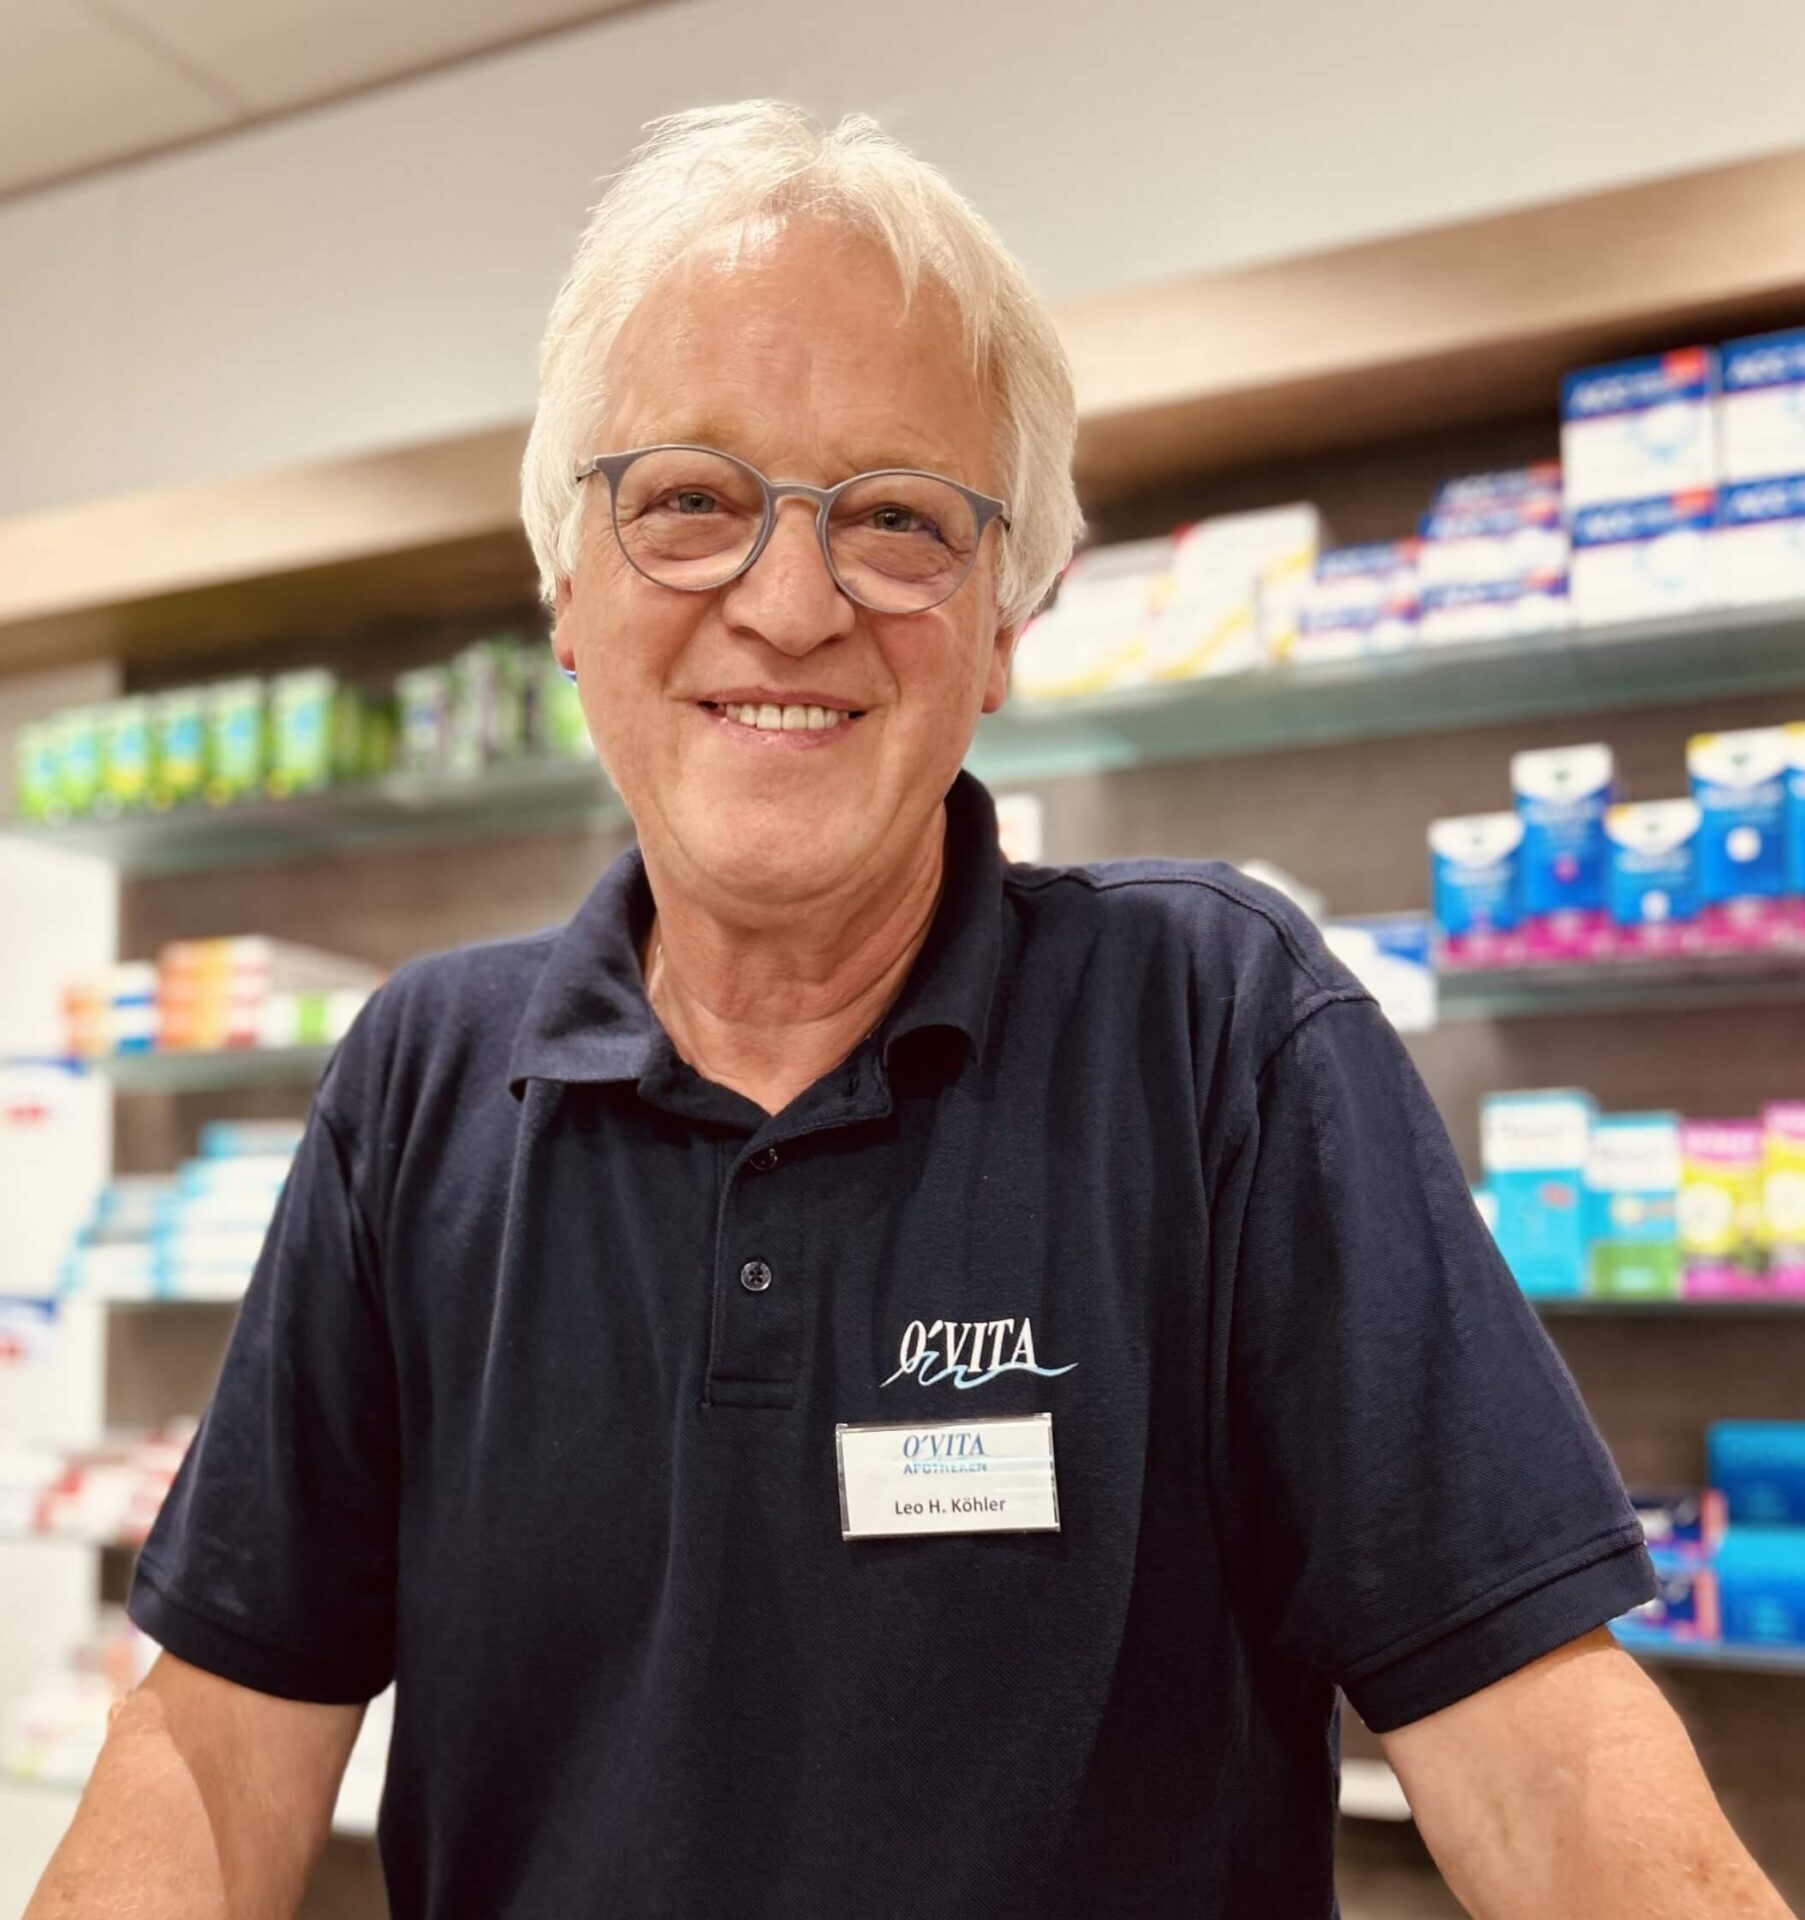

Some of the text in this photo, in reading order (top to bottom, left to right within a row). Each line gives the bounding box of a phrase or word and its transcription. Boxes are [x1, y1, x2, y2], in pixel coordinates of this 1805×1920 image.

[895, 1496, 1006, 1515] Leo H. Köhler
